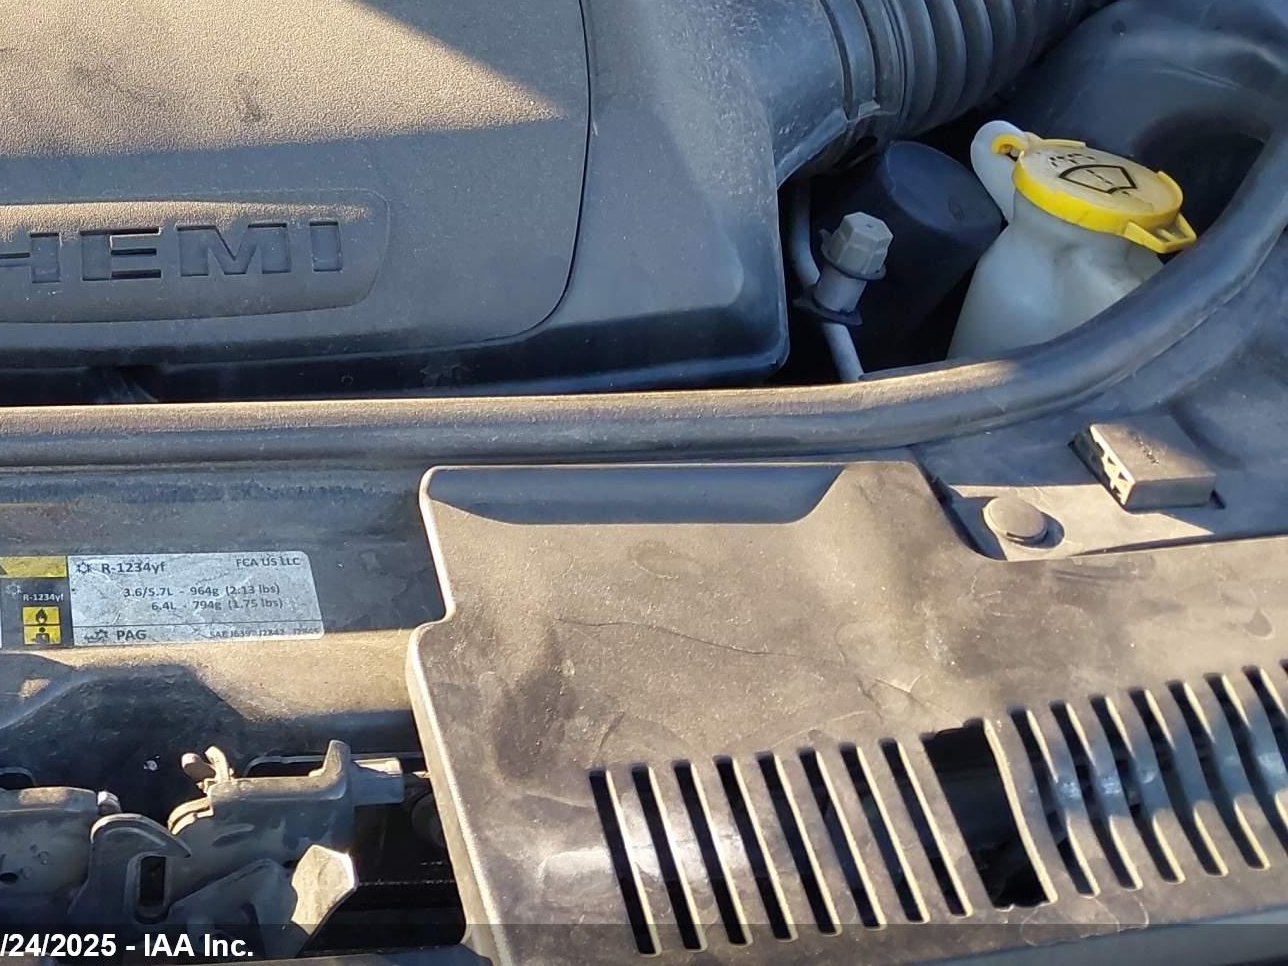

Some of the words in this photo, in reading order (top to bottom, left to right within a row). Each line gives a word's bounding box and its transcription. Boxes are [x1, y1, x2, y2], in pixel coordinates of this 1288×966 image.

[101, 561, 166, 574] R-1234yf
[235, 558, 259, 568] FCA
[262, 557, 278, 567] US
[280, 557, 301, 566] LLC
[123, 586, 174, 598] 3.6/5.7L
[190, 586, 220, 597] 964g
[258, 583, 280, 595] lbs)
[22, 593, 64, 603] R-1234yf
[151, 601, 176, 611] 6.4L
[192, 600, 222, 611] 794g
[228, 598, 258, 610] (1.75
[260, 598, 283, 609] lbs)
[116, 629, 147, 641] PAG
